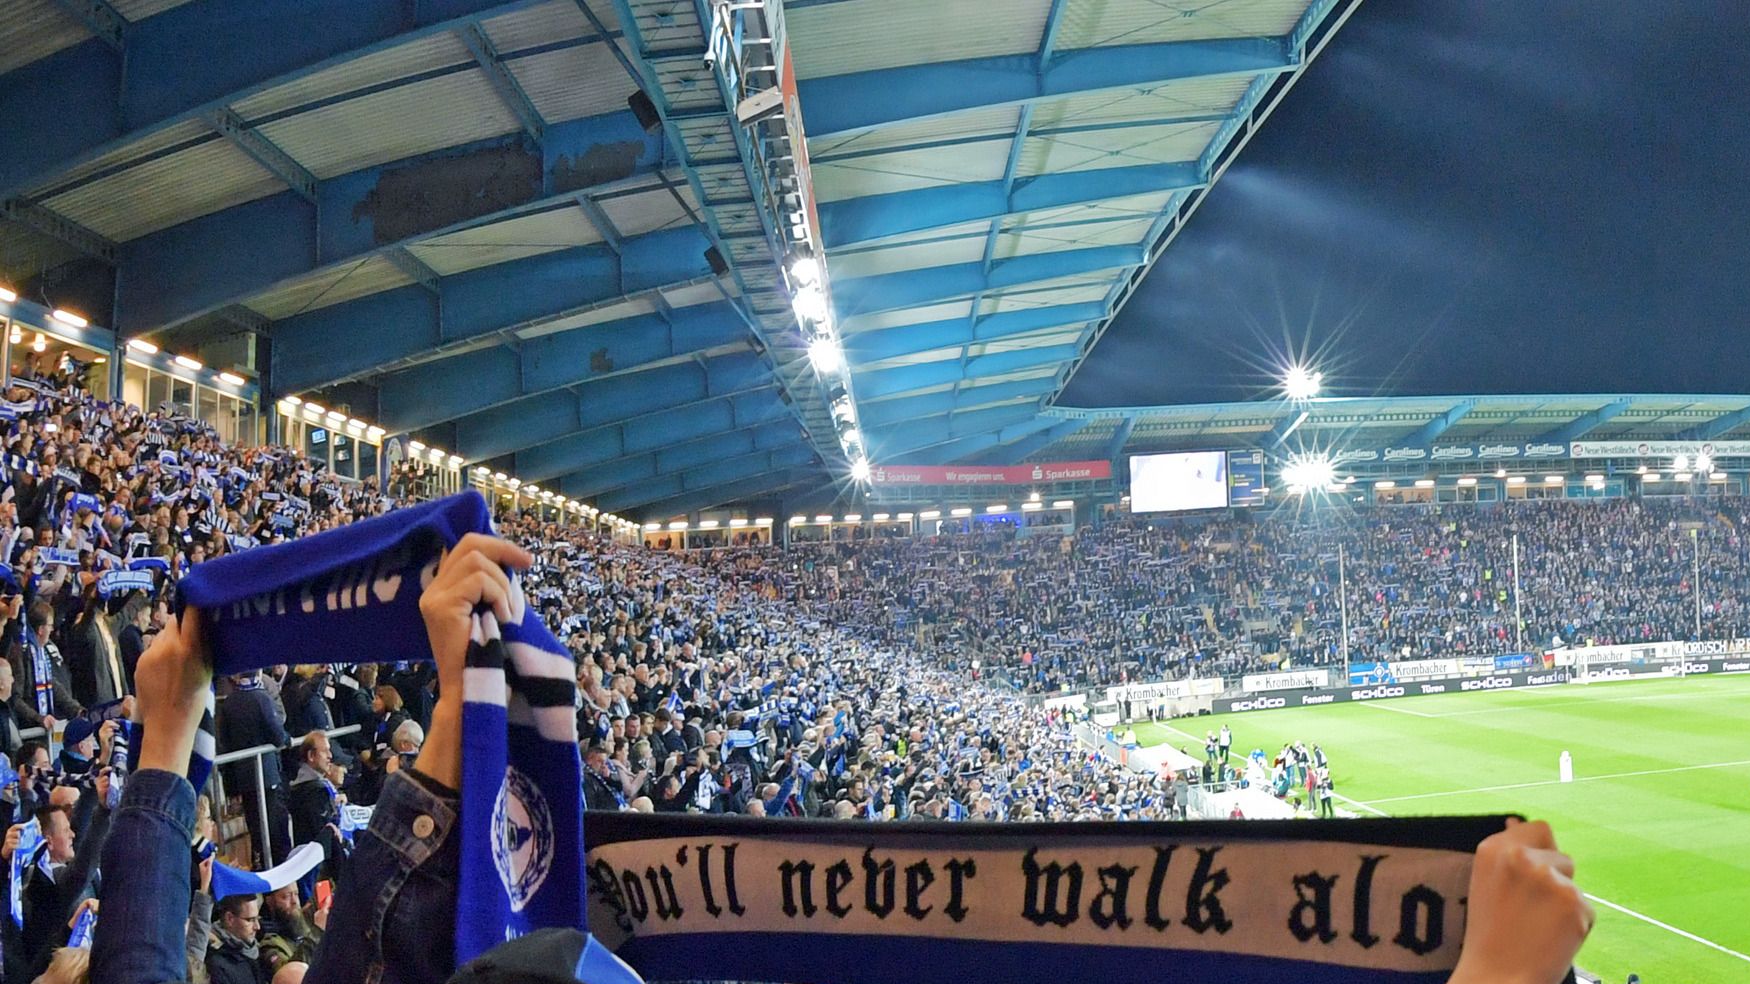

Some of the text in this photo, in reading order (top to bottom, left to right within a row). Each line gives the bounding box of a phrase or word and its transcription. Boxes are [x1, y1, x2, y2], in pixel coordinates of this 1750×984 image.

[1046, 468, 1091, 481] Sparkasse
[1395, 663, 1447, 676] Krombacher
[1265, 675, 1318, 688] Krombacher
[1125, 685, 1180, 699] Krombacher
[1231, 697, 1286, 712] SCHÜCO
[1302, 693, 1335, 705] Fenster
[1351, 685, 1405, 700] SCHÜCO
[1420, 683, 1445, 694] Türen
[1461, 676, 1513, 690] SCHÜCO
[778, 844, 976, 923] never
[1020, 838, 1234, 936] walk
[1287, 853, 1468, 956] alo
